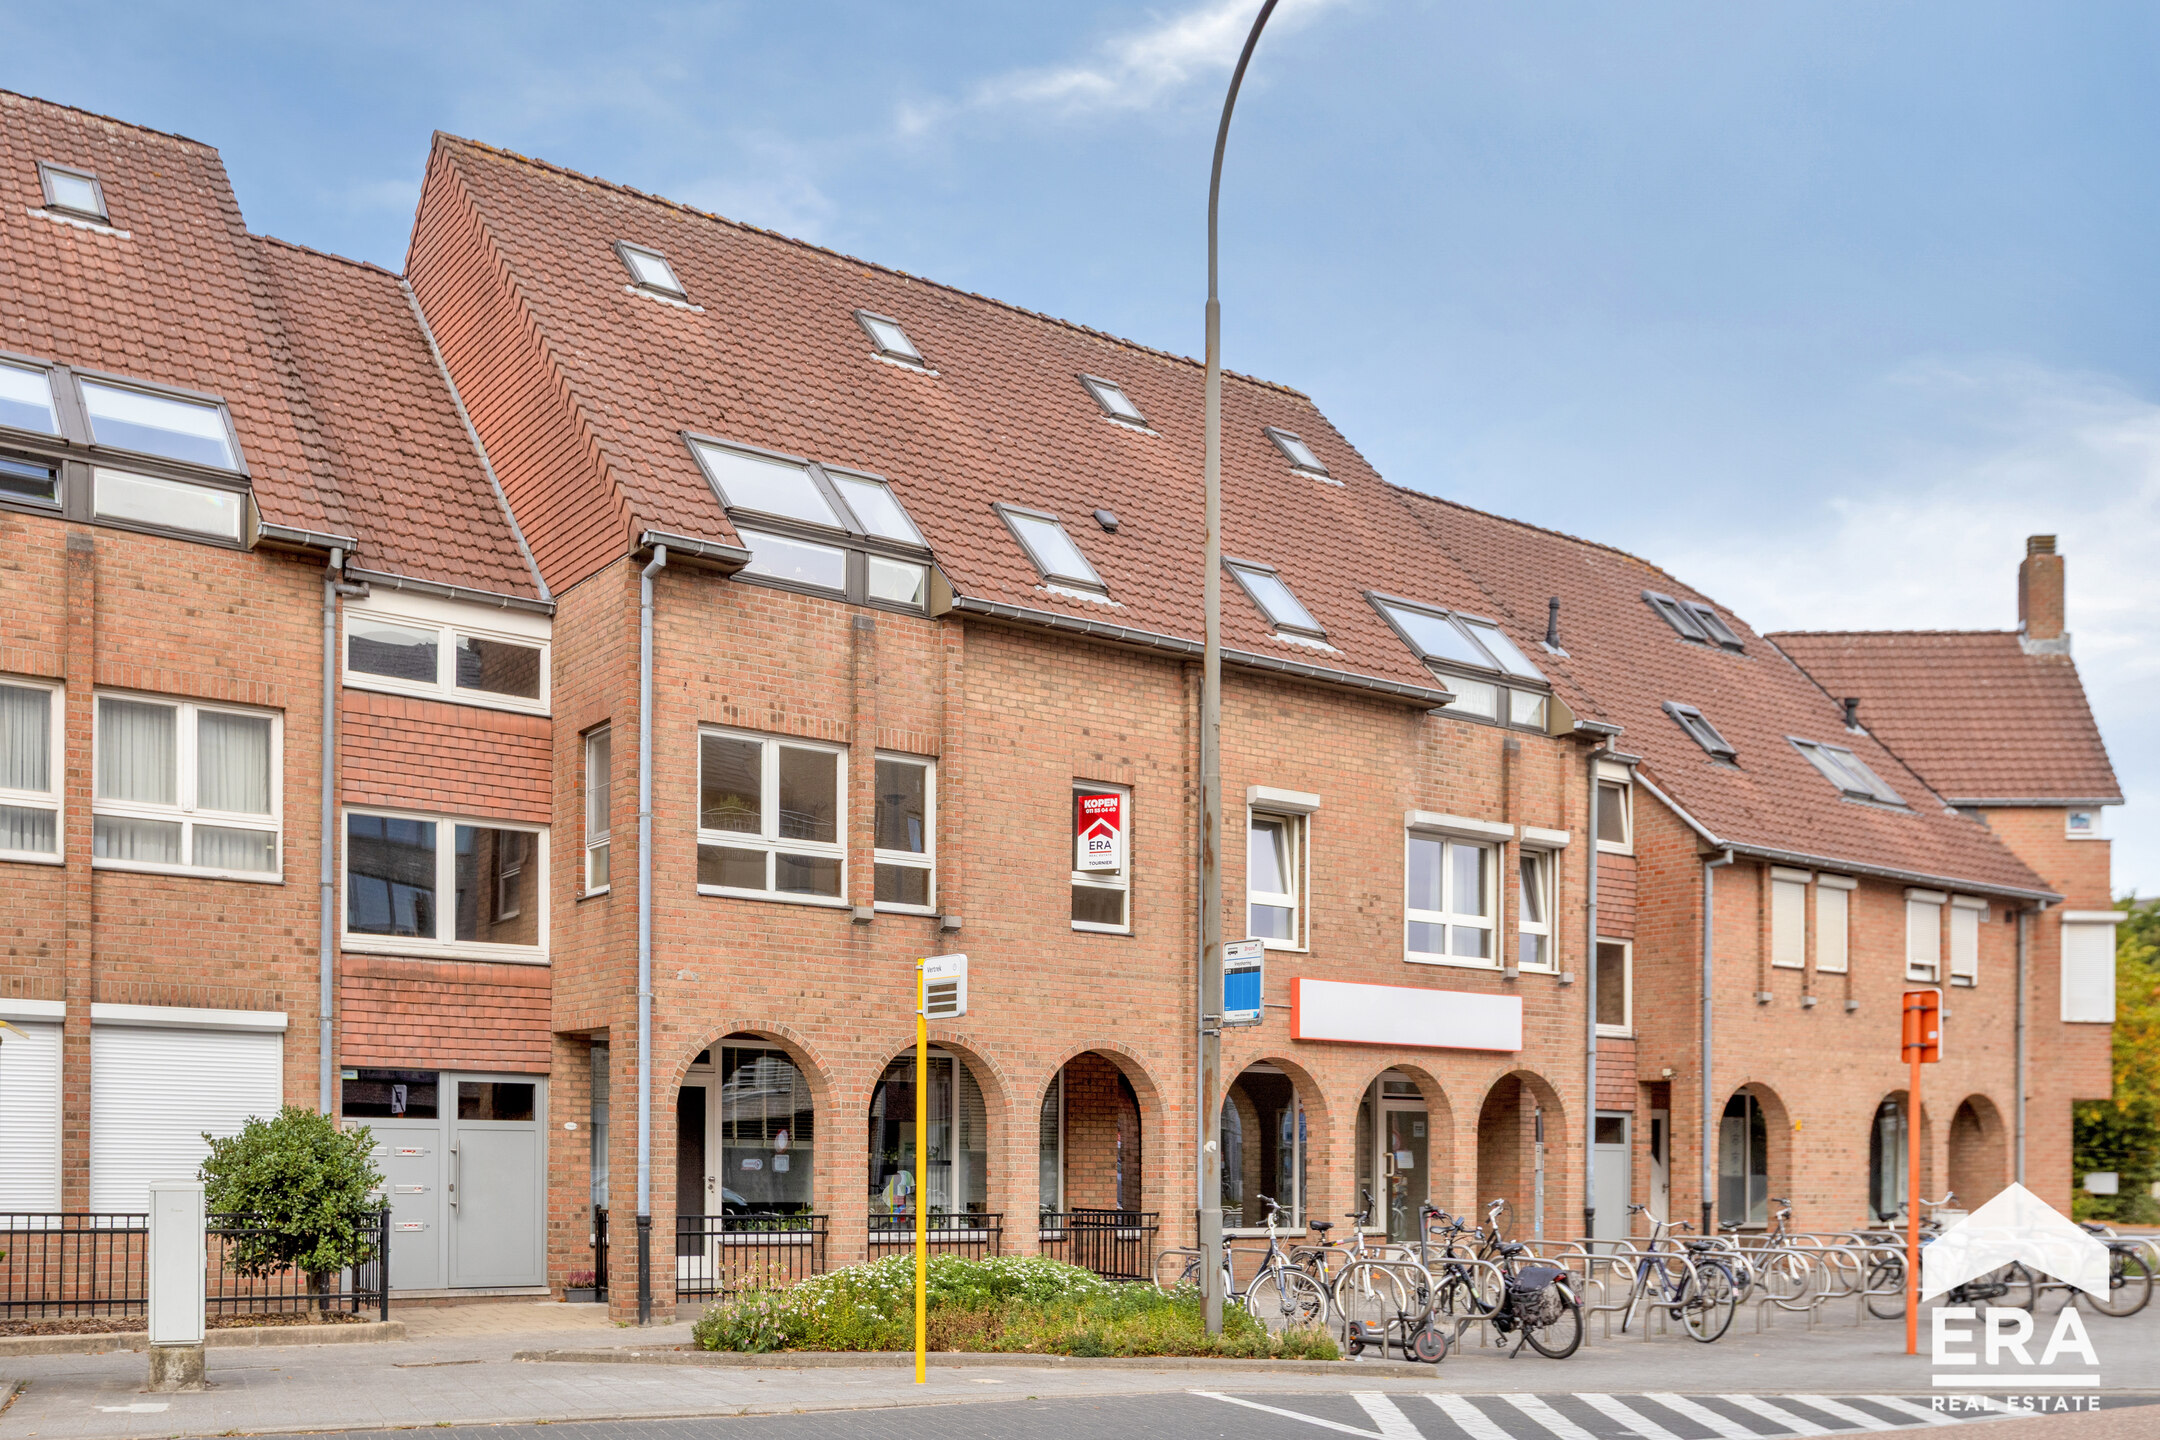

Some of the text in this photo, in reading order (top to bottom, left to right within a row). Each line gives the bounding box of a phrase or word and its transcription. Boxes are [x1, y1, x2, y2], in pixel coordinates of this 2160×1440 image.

[1084, 798, 1118, 809] KOPEN
[1089, 841, 1112, 850] ERA
[927, 965, 942, 973] Vertrek
